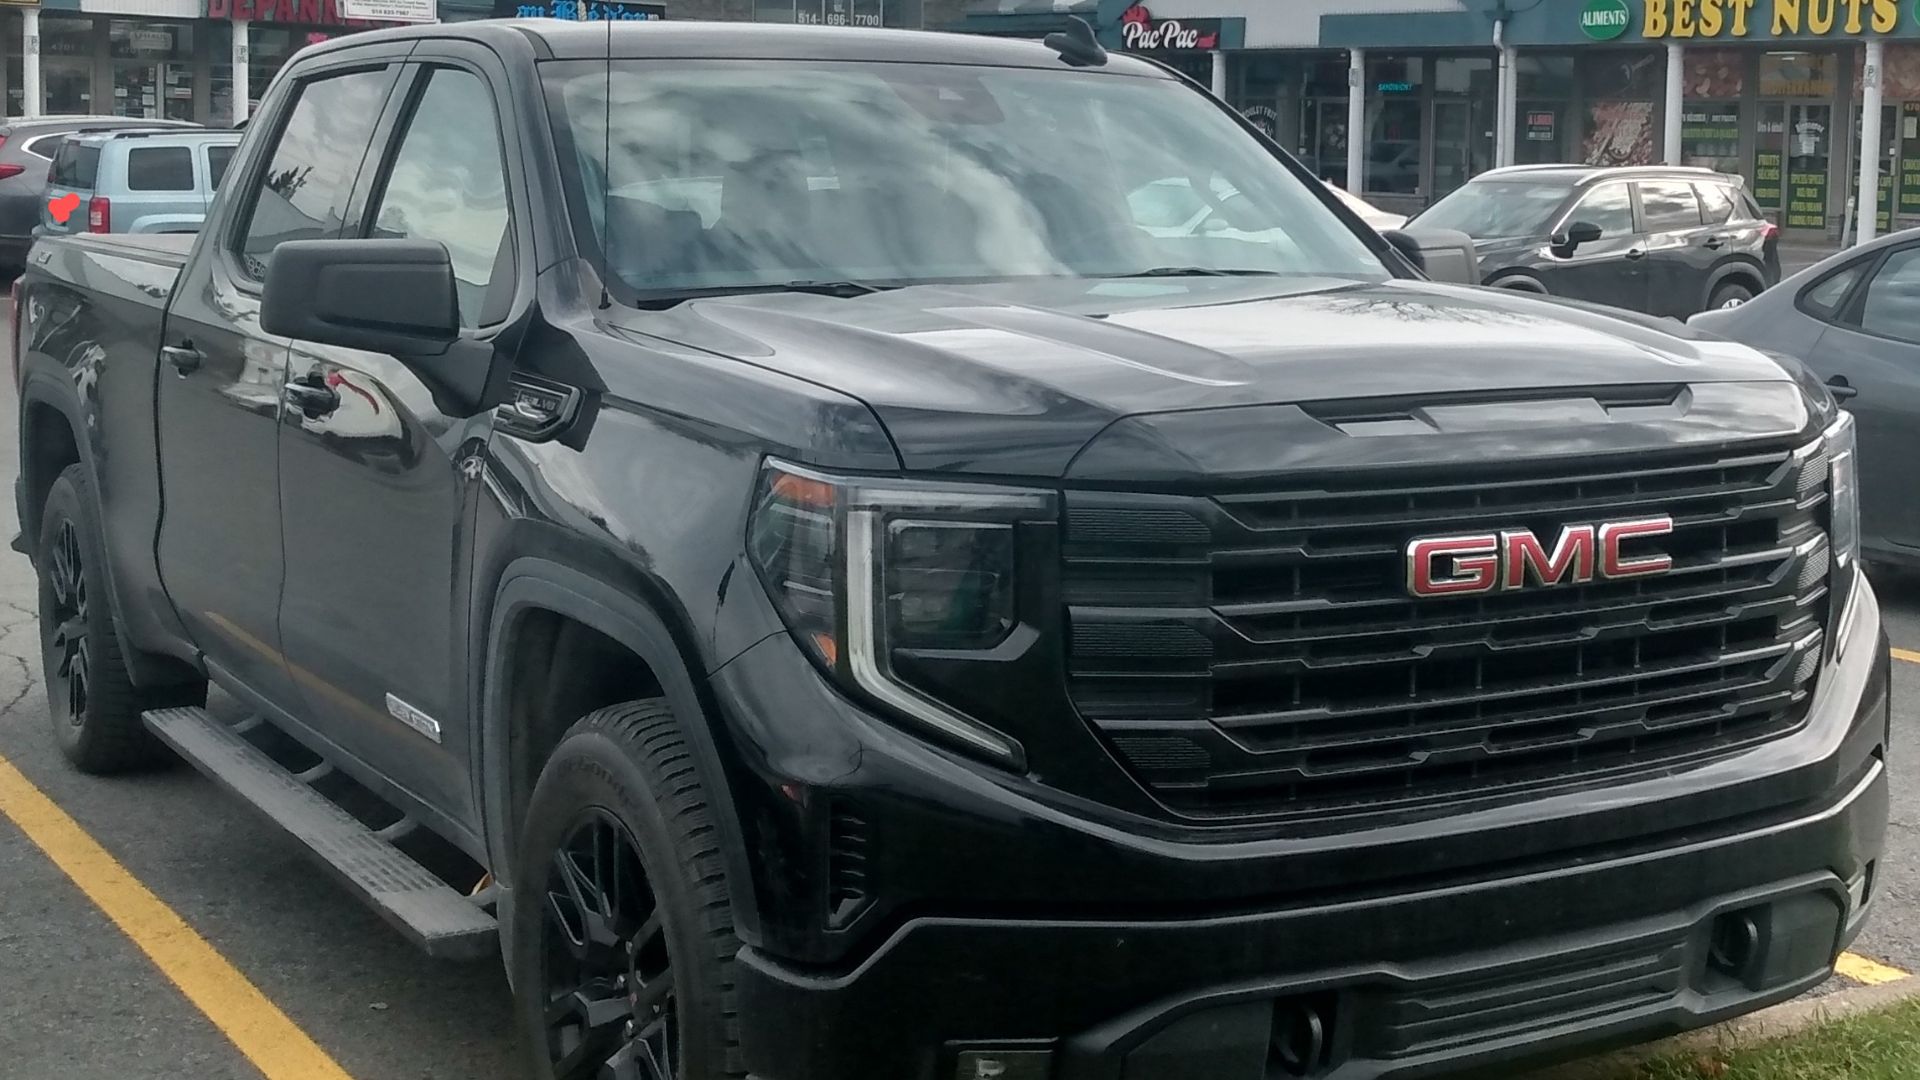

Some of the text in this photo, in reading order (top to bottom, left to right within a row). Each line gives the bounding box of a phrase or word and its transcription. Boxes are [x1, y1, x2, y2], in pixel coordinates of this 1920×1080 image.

[855, 15, 879, 26] 7700
[1581, 9, 1626, 27] ALIMENTS
[1642, 0, 1898, 38] BEST NUTS
[1123, 20, 1199, 48] Pac Pac
[1406, 516, 1673, 597] GMC
